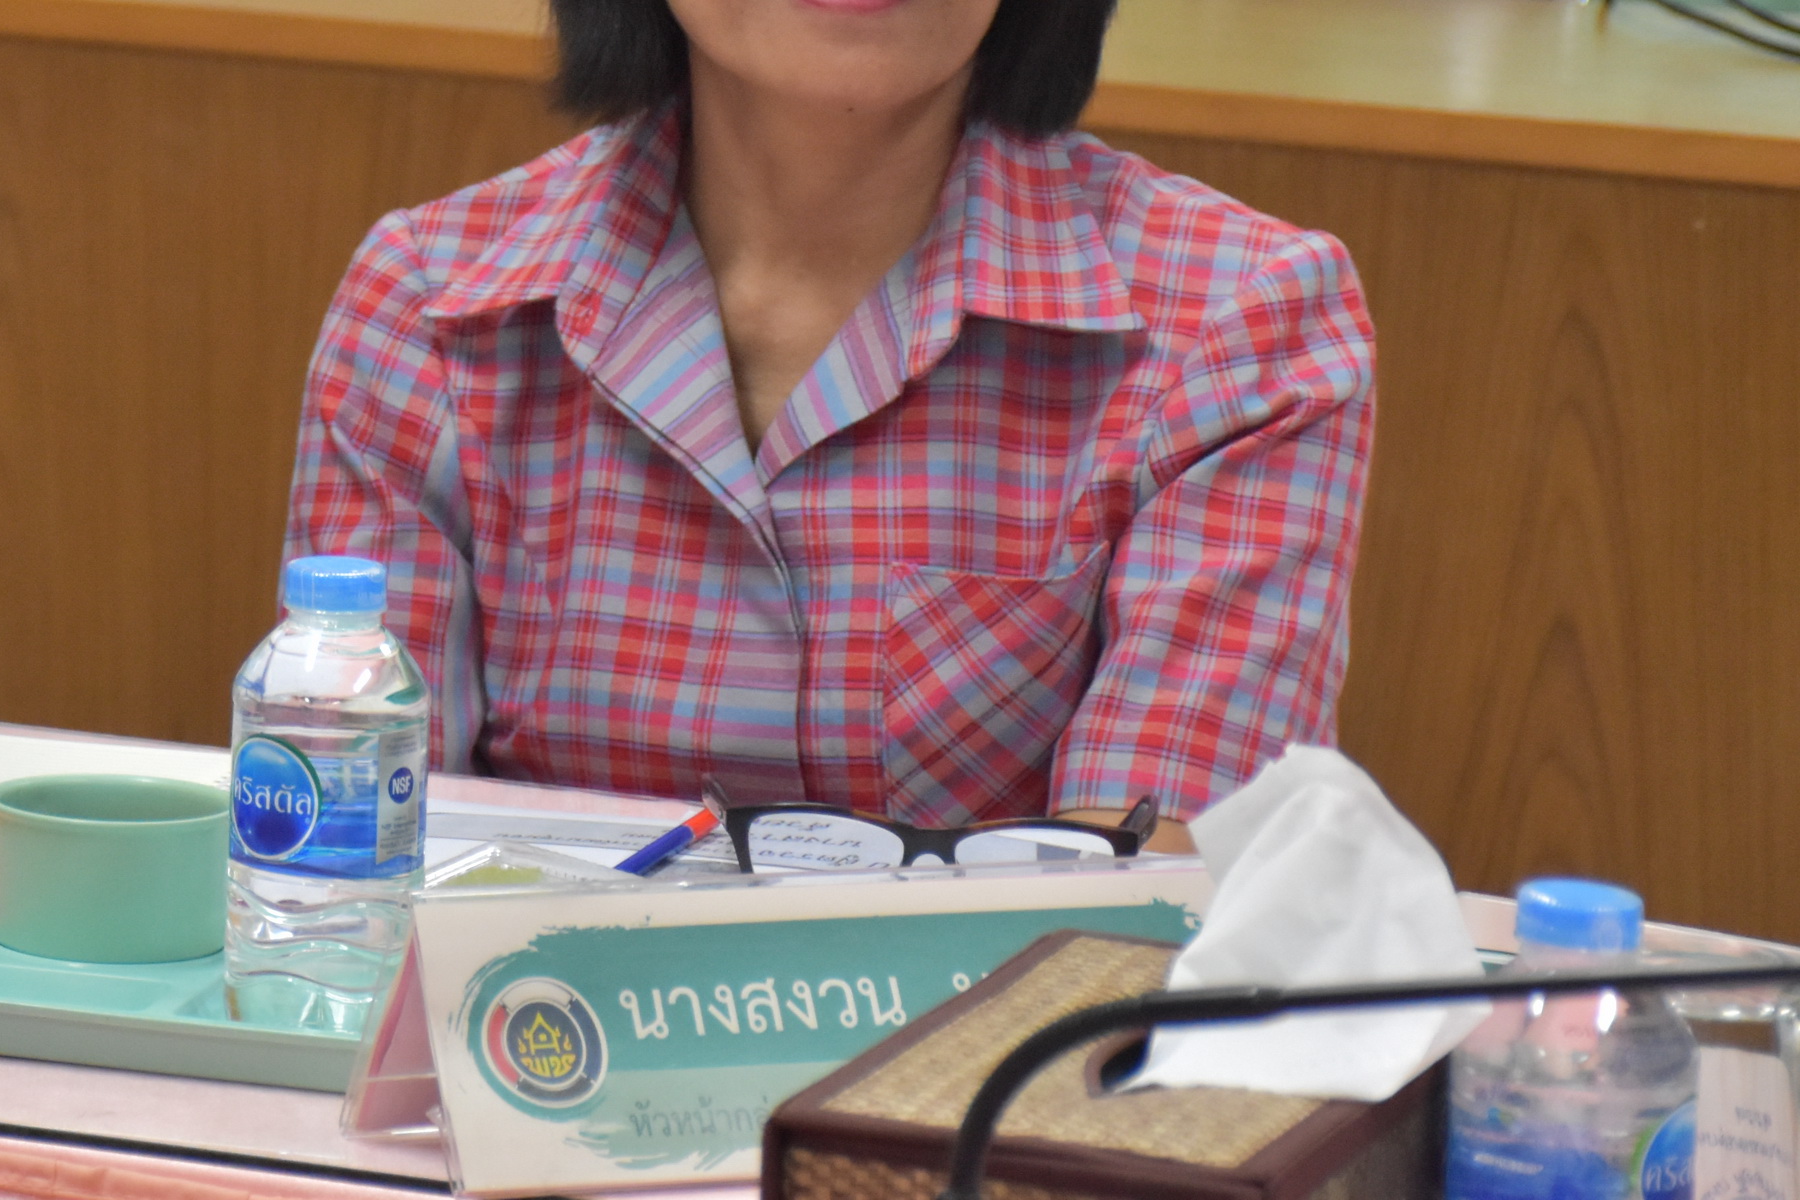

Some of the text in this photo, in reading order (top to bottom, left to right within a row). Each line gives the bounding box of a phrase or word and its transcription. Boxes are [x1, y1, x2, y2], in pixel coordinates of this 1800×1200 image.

[391, 775, 412, 795] NSF
[619, 976, 907, 1040] นางสงวน
